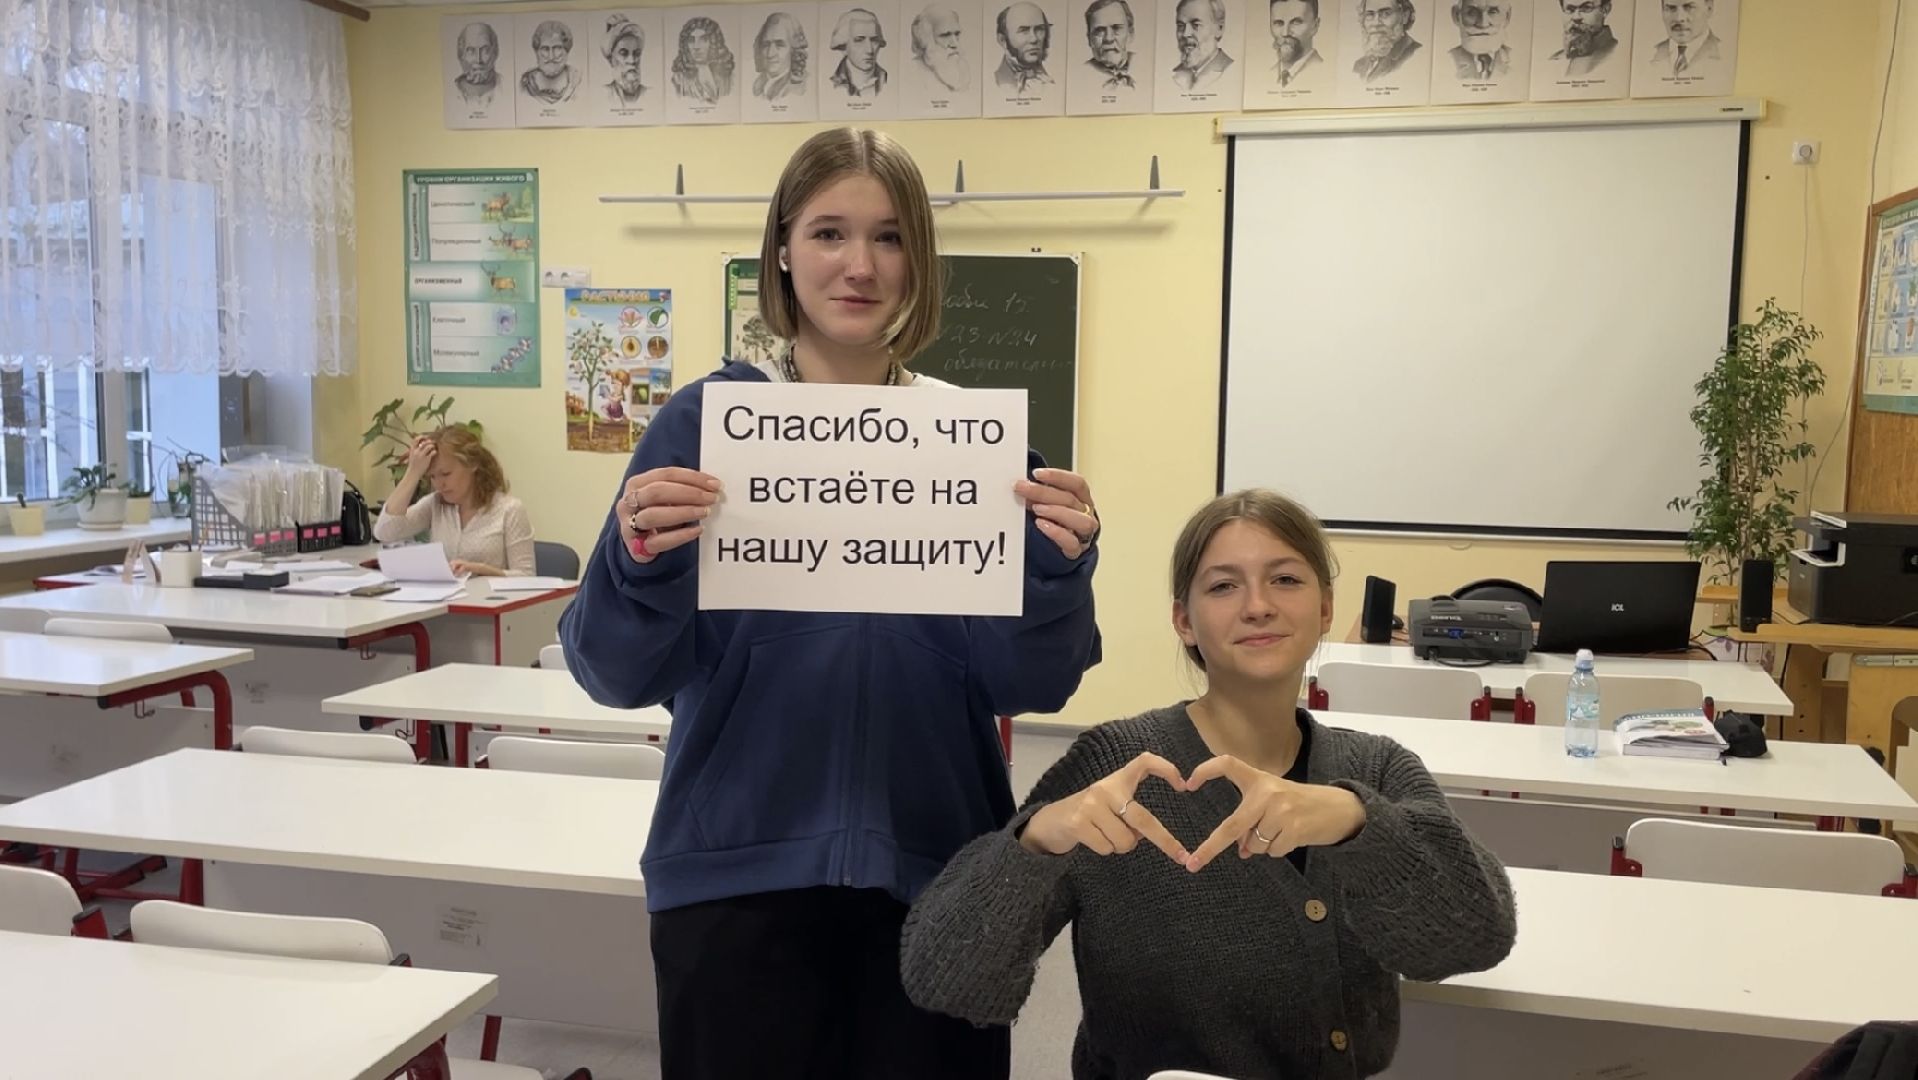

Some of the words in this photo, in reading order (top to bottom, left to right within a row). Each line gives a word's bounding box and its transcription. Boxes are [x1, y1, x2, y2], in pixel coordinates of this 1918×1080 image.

[723, 405, 919, 449] Спасибо,
[935, 417, 1005, 445] что
[749, 470, 915, 504] встаёте
[931, 478, 978, 505] на
[718, 537, 828, 573] нашу
[842, 531, 1006, 575] защиту!
